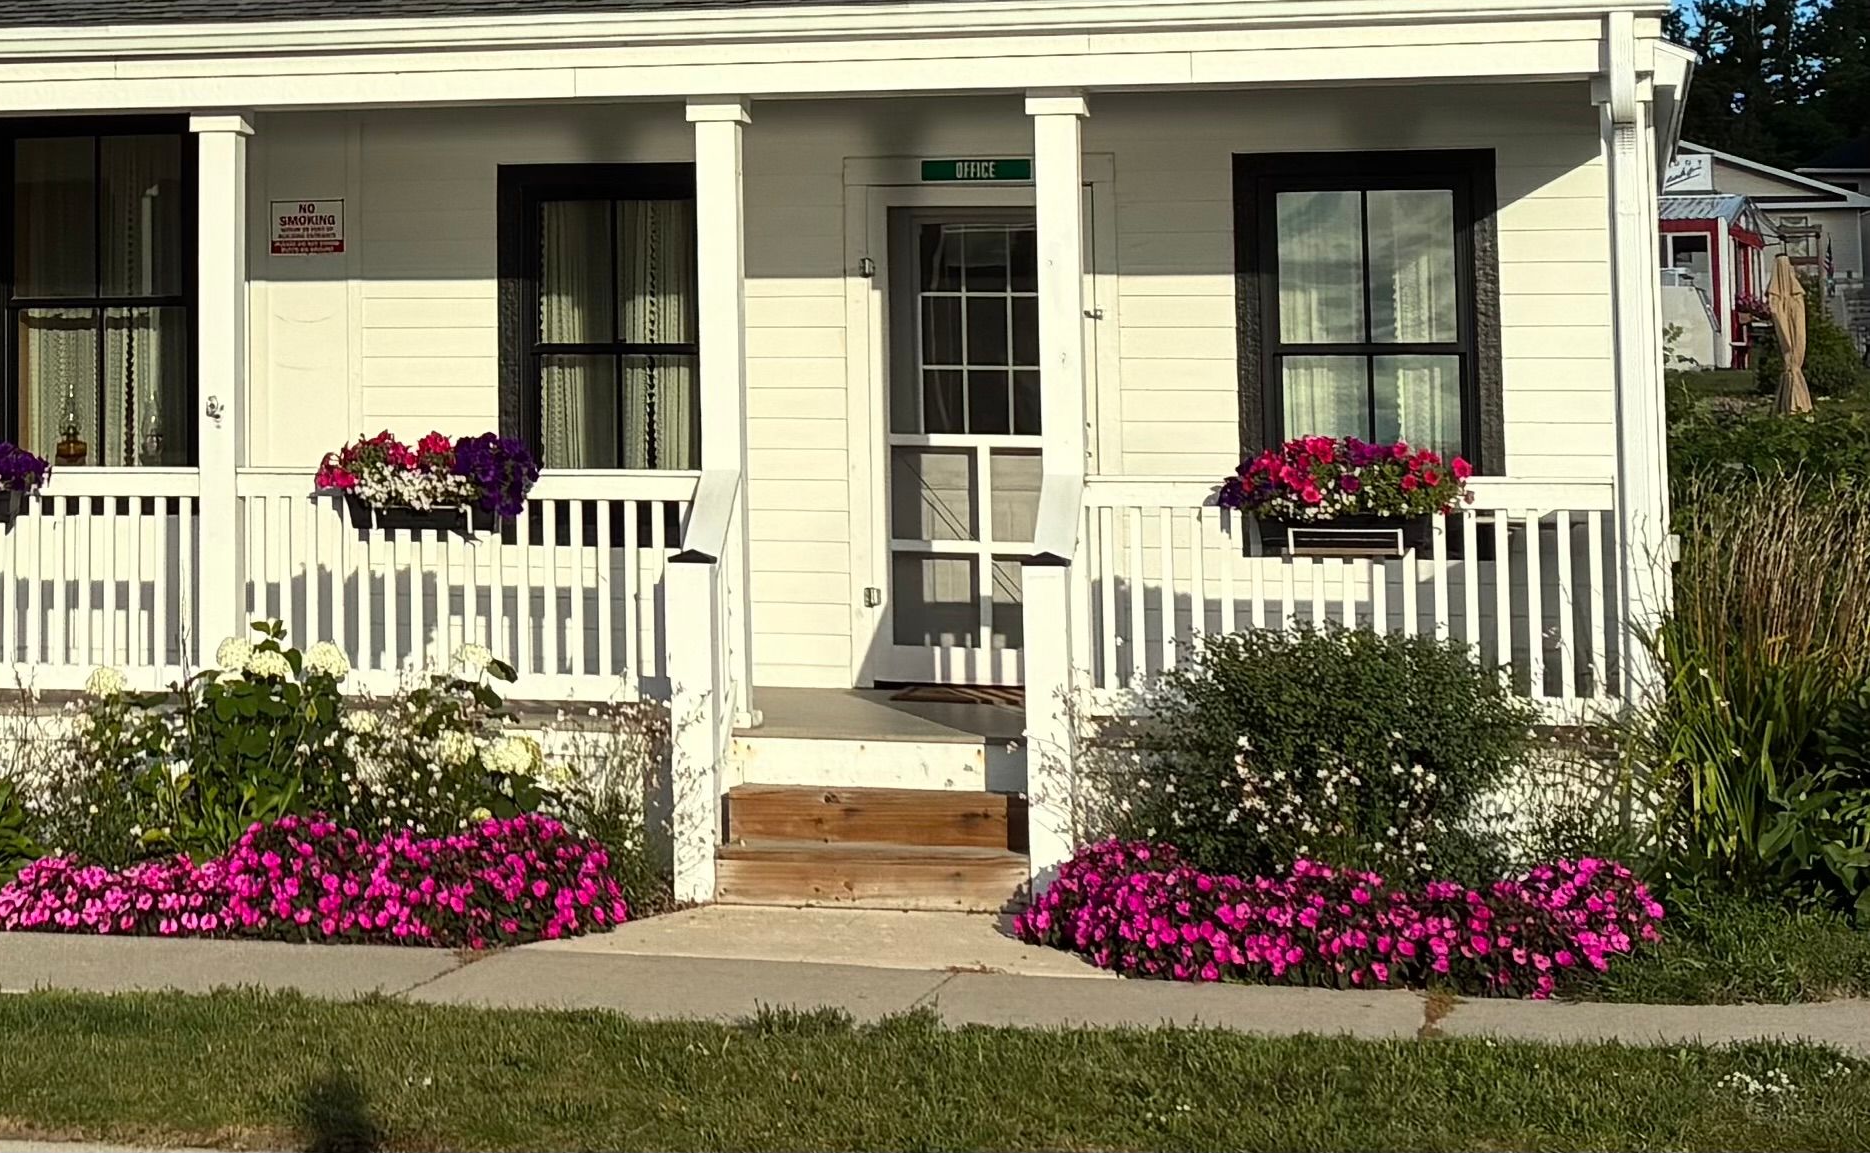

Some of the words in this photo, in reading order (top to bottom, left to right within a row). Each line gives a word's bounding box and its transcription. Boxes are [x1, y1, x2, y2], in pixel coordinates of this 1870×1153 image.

[955, 161, 996, 179] OFFICE
[298, 203, 316, 214] NO
[279, 215, 336, 226] SMOKING
